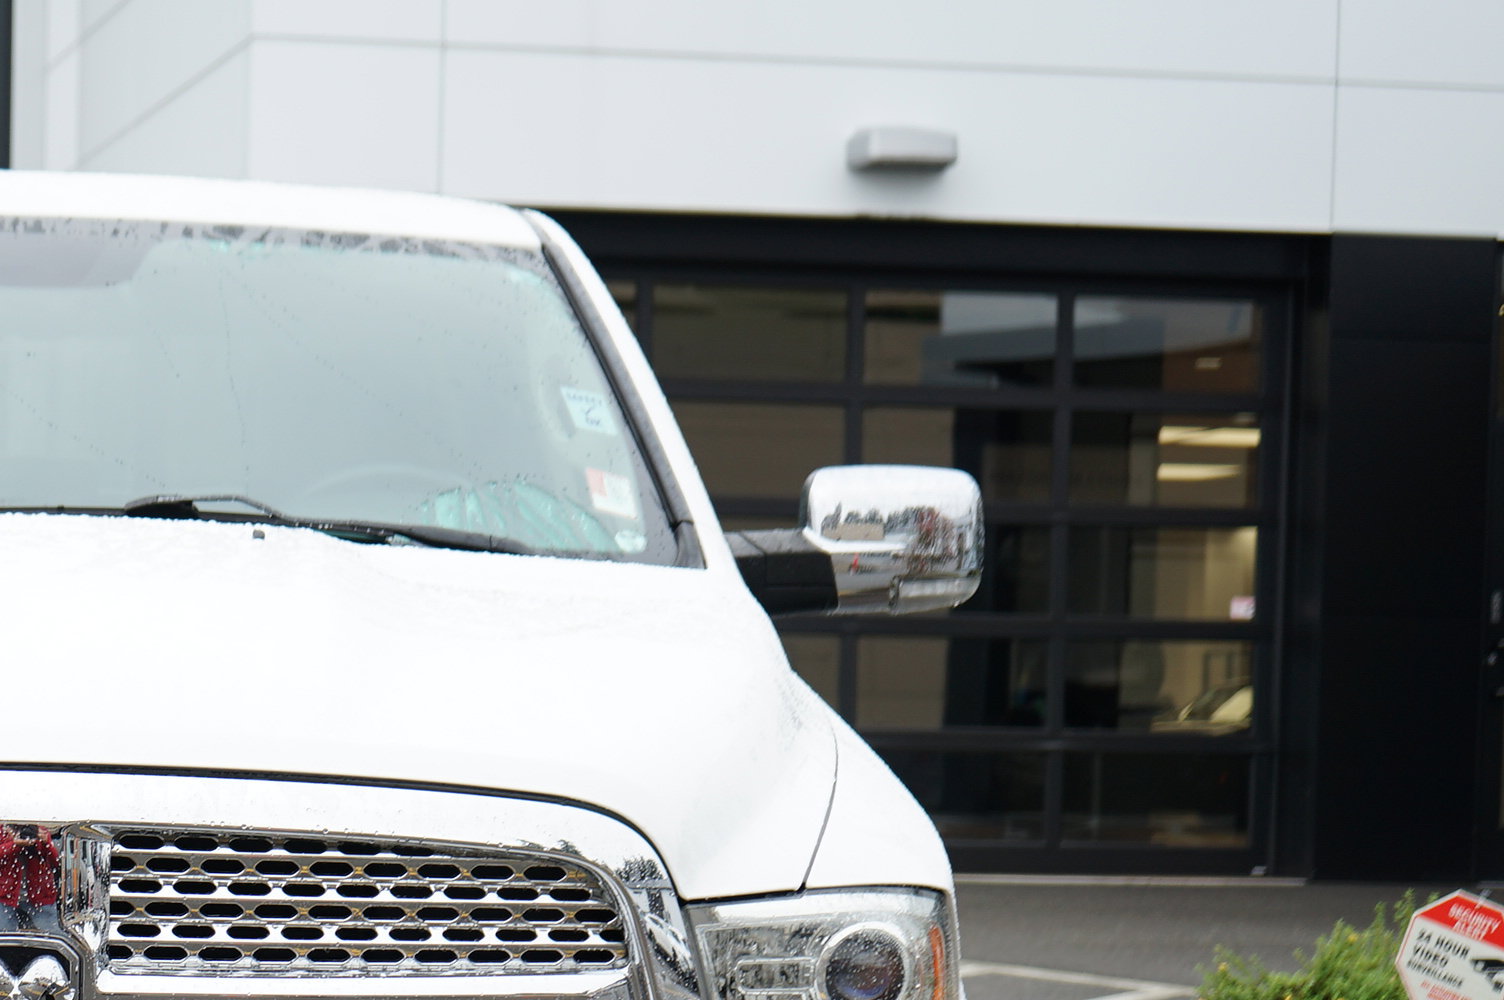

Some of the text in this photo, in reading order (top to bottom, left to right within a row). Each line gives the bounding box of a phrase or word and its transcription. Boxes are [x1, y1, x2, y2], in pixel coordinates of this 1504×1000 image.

[1449, 904, 1501, 934] SECURITY
[1453, 921, 1488, 941] ALERT
[1413, 943, 1449, 968] VIDEO
[1435, 934, 1471, 959] HOUR
[1407, 959, 1463, 988] SURVEILLANCE
